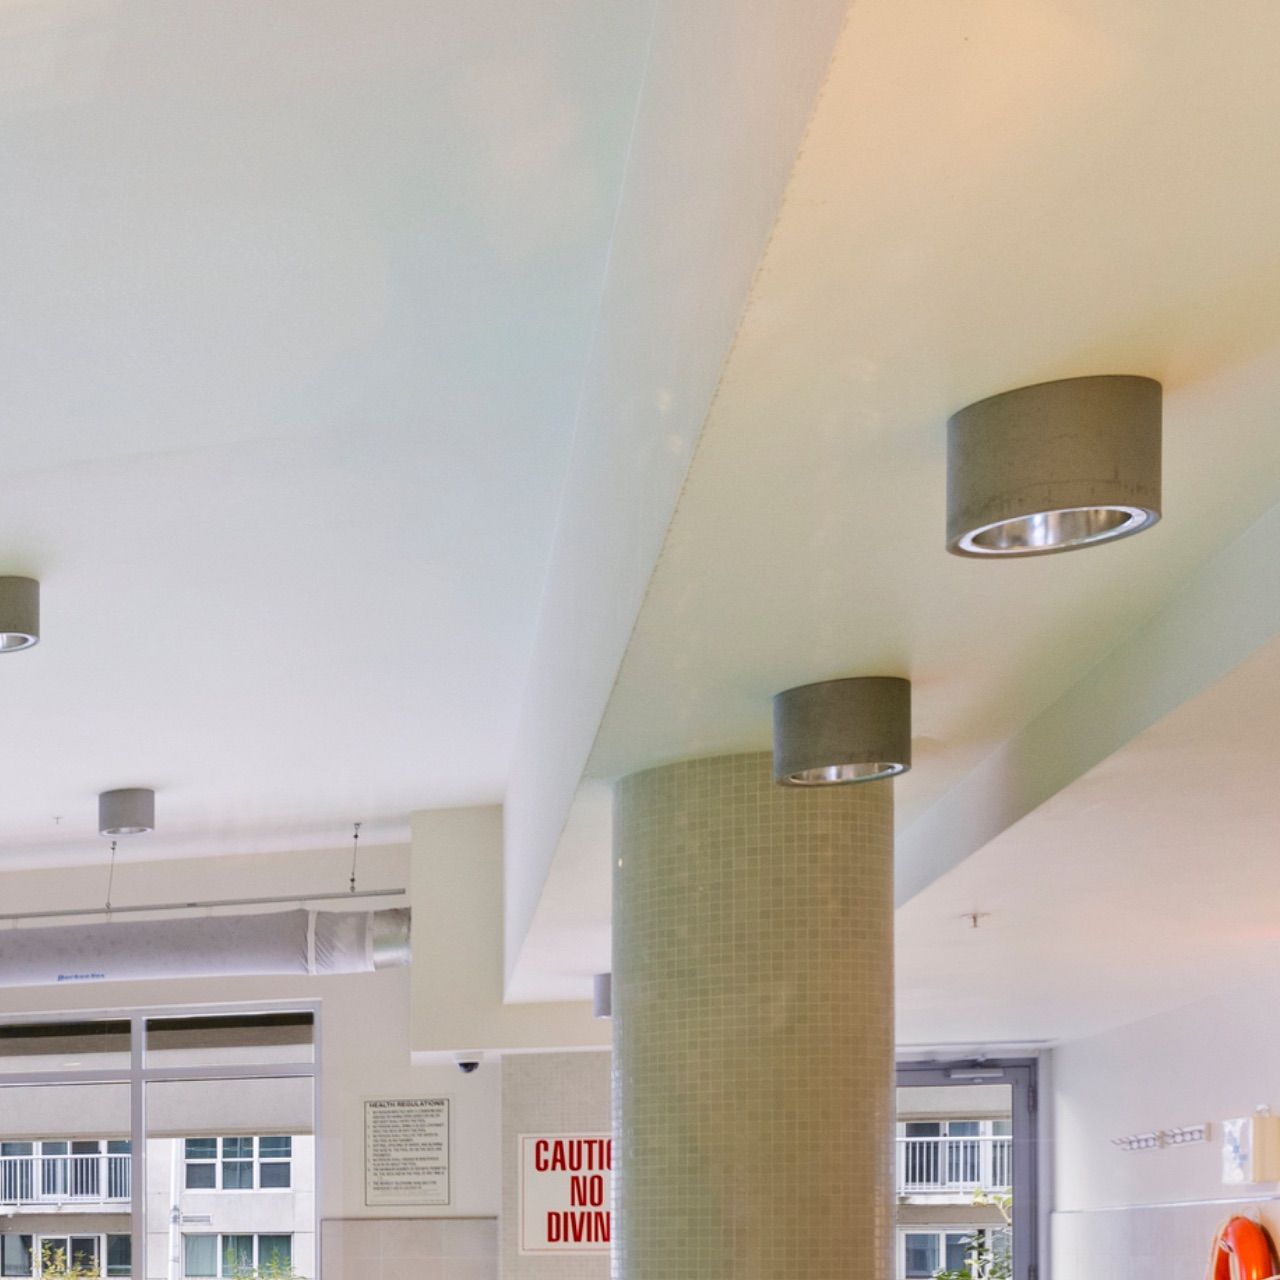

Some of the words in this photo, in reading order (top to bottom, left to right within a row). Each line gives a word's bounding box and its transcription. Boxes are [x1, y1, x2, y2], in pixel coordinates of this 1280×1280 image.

[369, 1101, 396, 1109] HEALTH
[397, 1099, 445, 1108] REGULATIONS
[535, 1139, 612, 1172] CAUTI
[570, 1174, 604, 1207] NO
[547, 1211, 611, 1243] DIVIN
